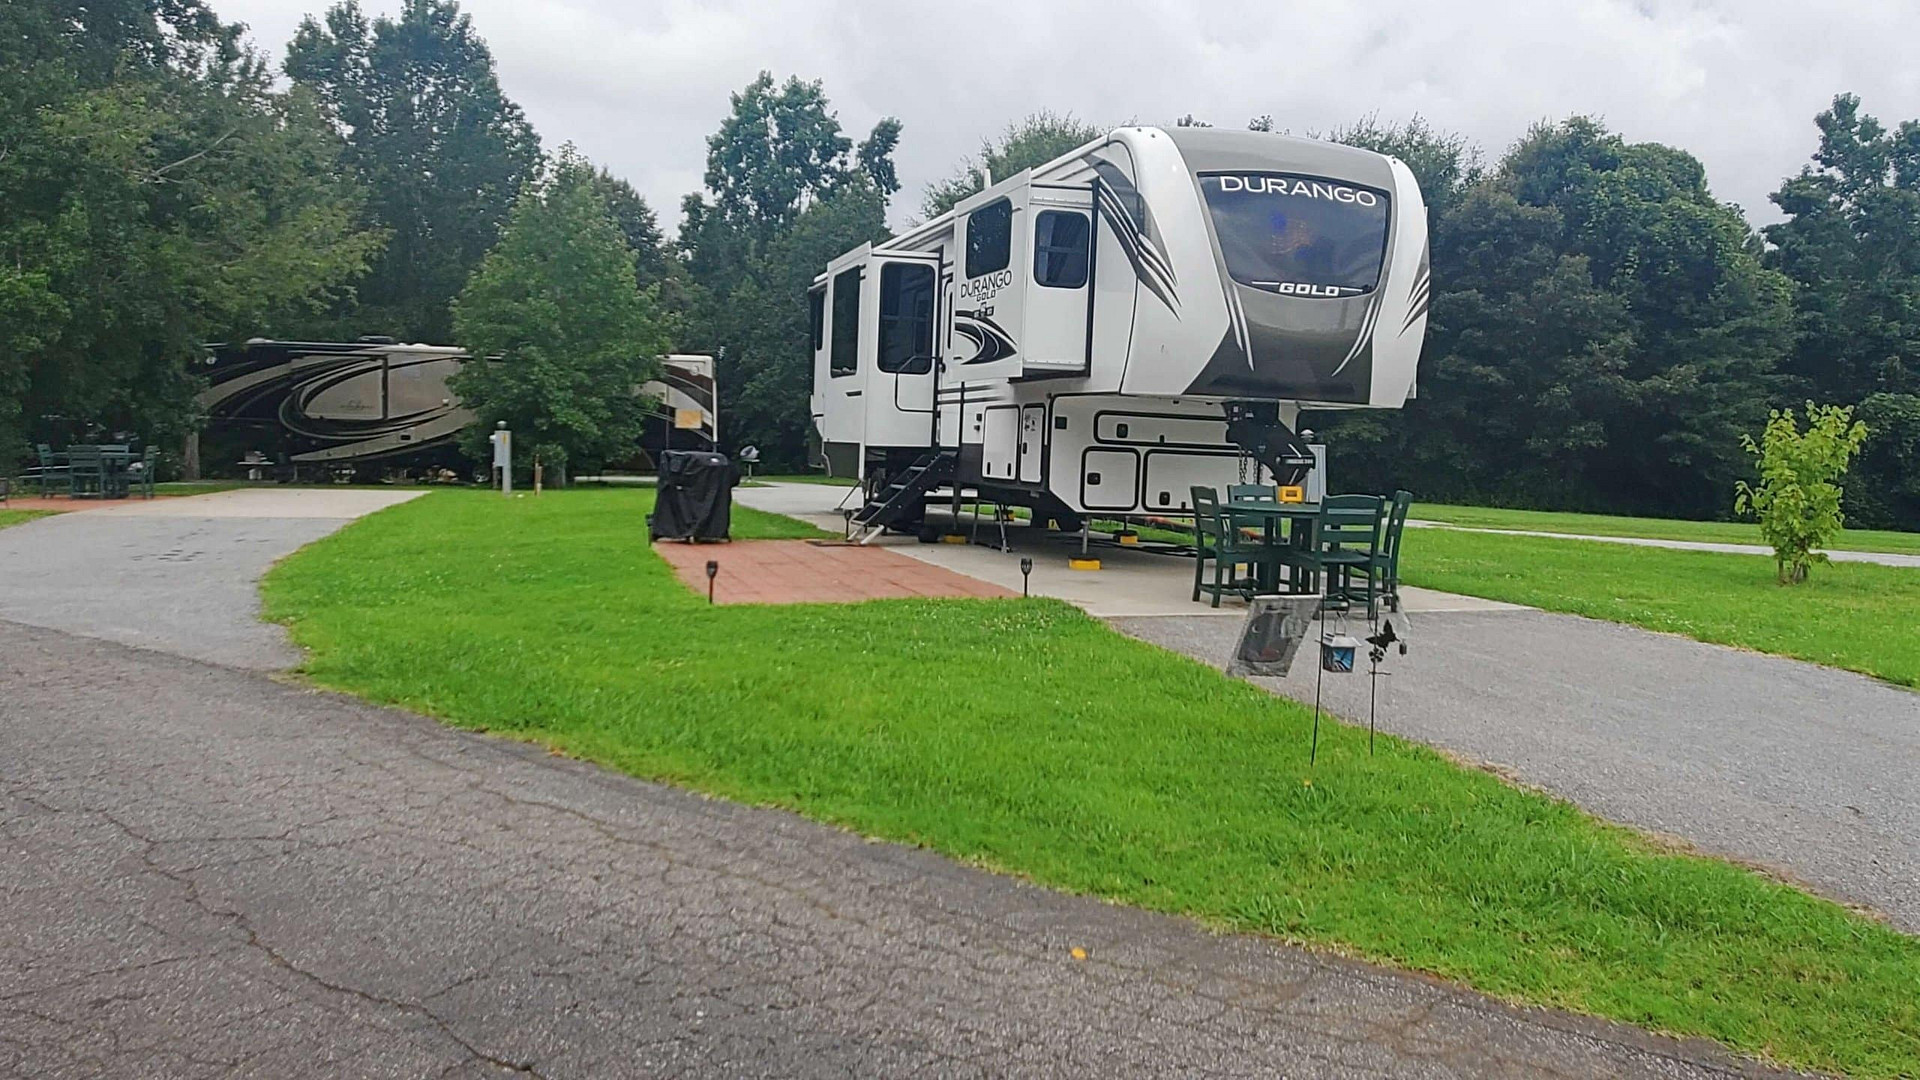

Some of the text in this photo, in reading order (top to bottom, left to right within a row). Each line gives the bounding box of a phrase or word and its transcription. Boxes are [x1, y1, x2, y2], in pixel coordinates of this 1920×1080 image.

[1220, 176, 1376, 206] DURANGO
[961, 270, 1012, 298] DURANGO
[1279, 283, 1339, 297] GOLD
[977, 290, 996, 302] GOLD
